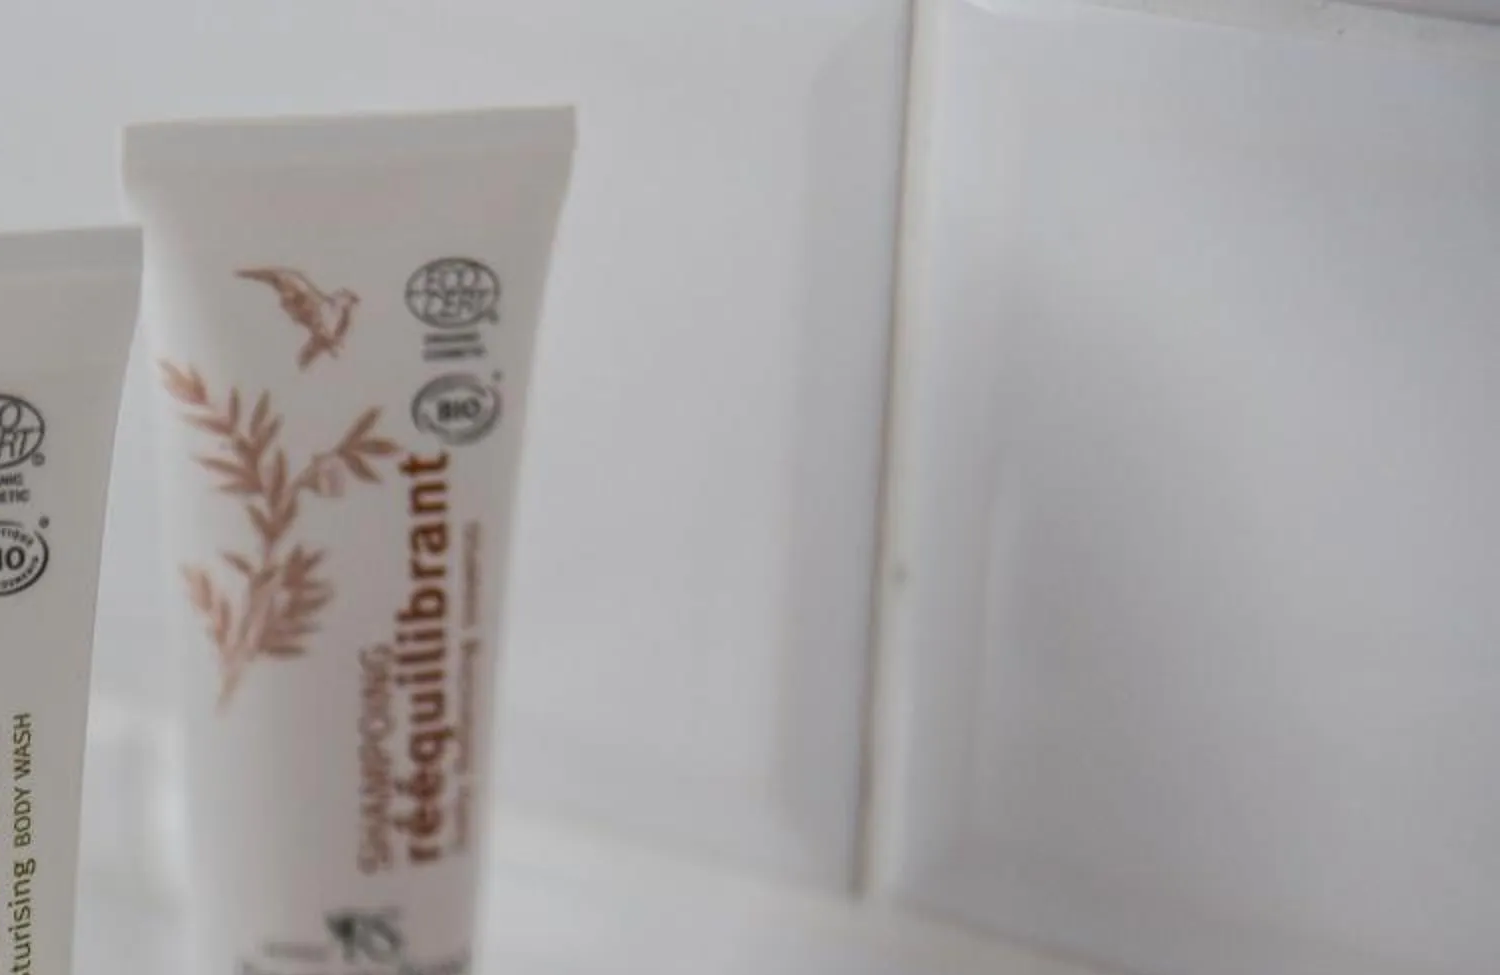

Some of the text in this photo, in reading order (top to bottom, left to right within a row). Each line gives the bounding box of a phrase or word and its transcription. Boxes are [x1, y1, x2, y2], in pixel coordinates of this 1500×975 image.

[394, 450, 454, 864] rééquilibrant
[11, 712, 33, 783] WASH
[12, 786, 33, 847] BODY
